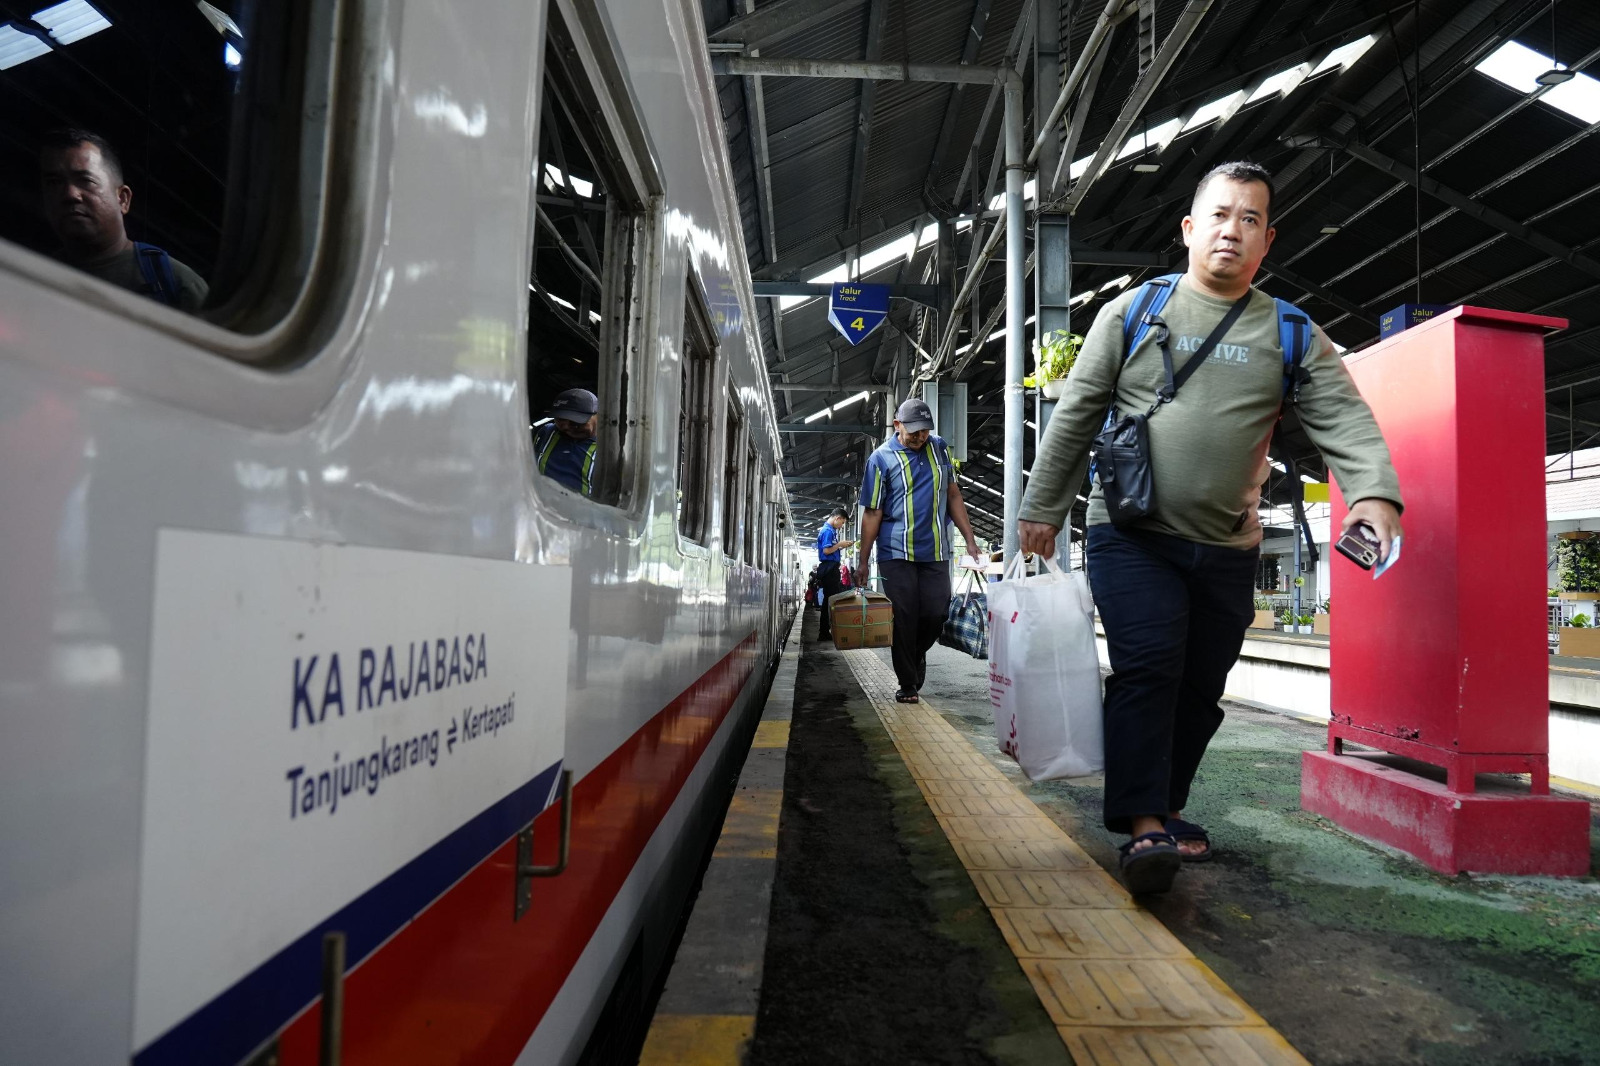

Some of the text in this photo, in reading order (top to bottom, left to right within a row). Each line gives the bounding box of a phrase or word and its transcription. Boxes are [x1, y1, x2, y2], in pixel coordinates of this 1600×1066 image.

[840, 286, 861, 295] Jalur
[840, 294, 857, 302] Track
[1412, 308, 1434, 317] Jalur
[850, 317, 865, 331] 4
[1175, 335, 1249, 363] ACIVE
[291, 632, 488, 731] KA RAJABASA
[286, 691, 516, 820] Tanjungkarang Kertapati
